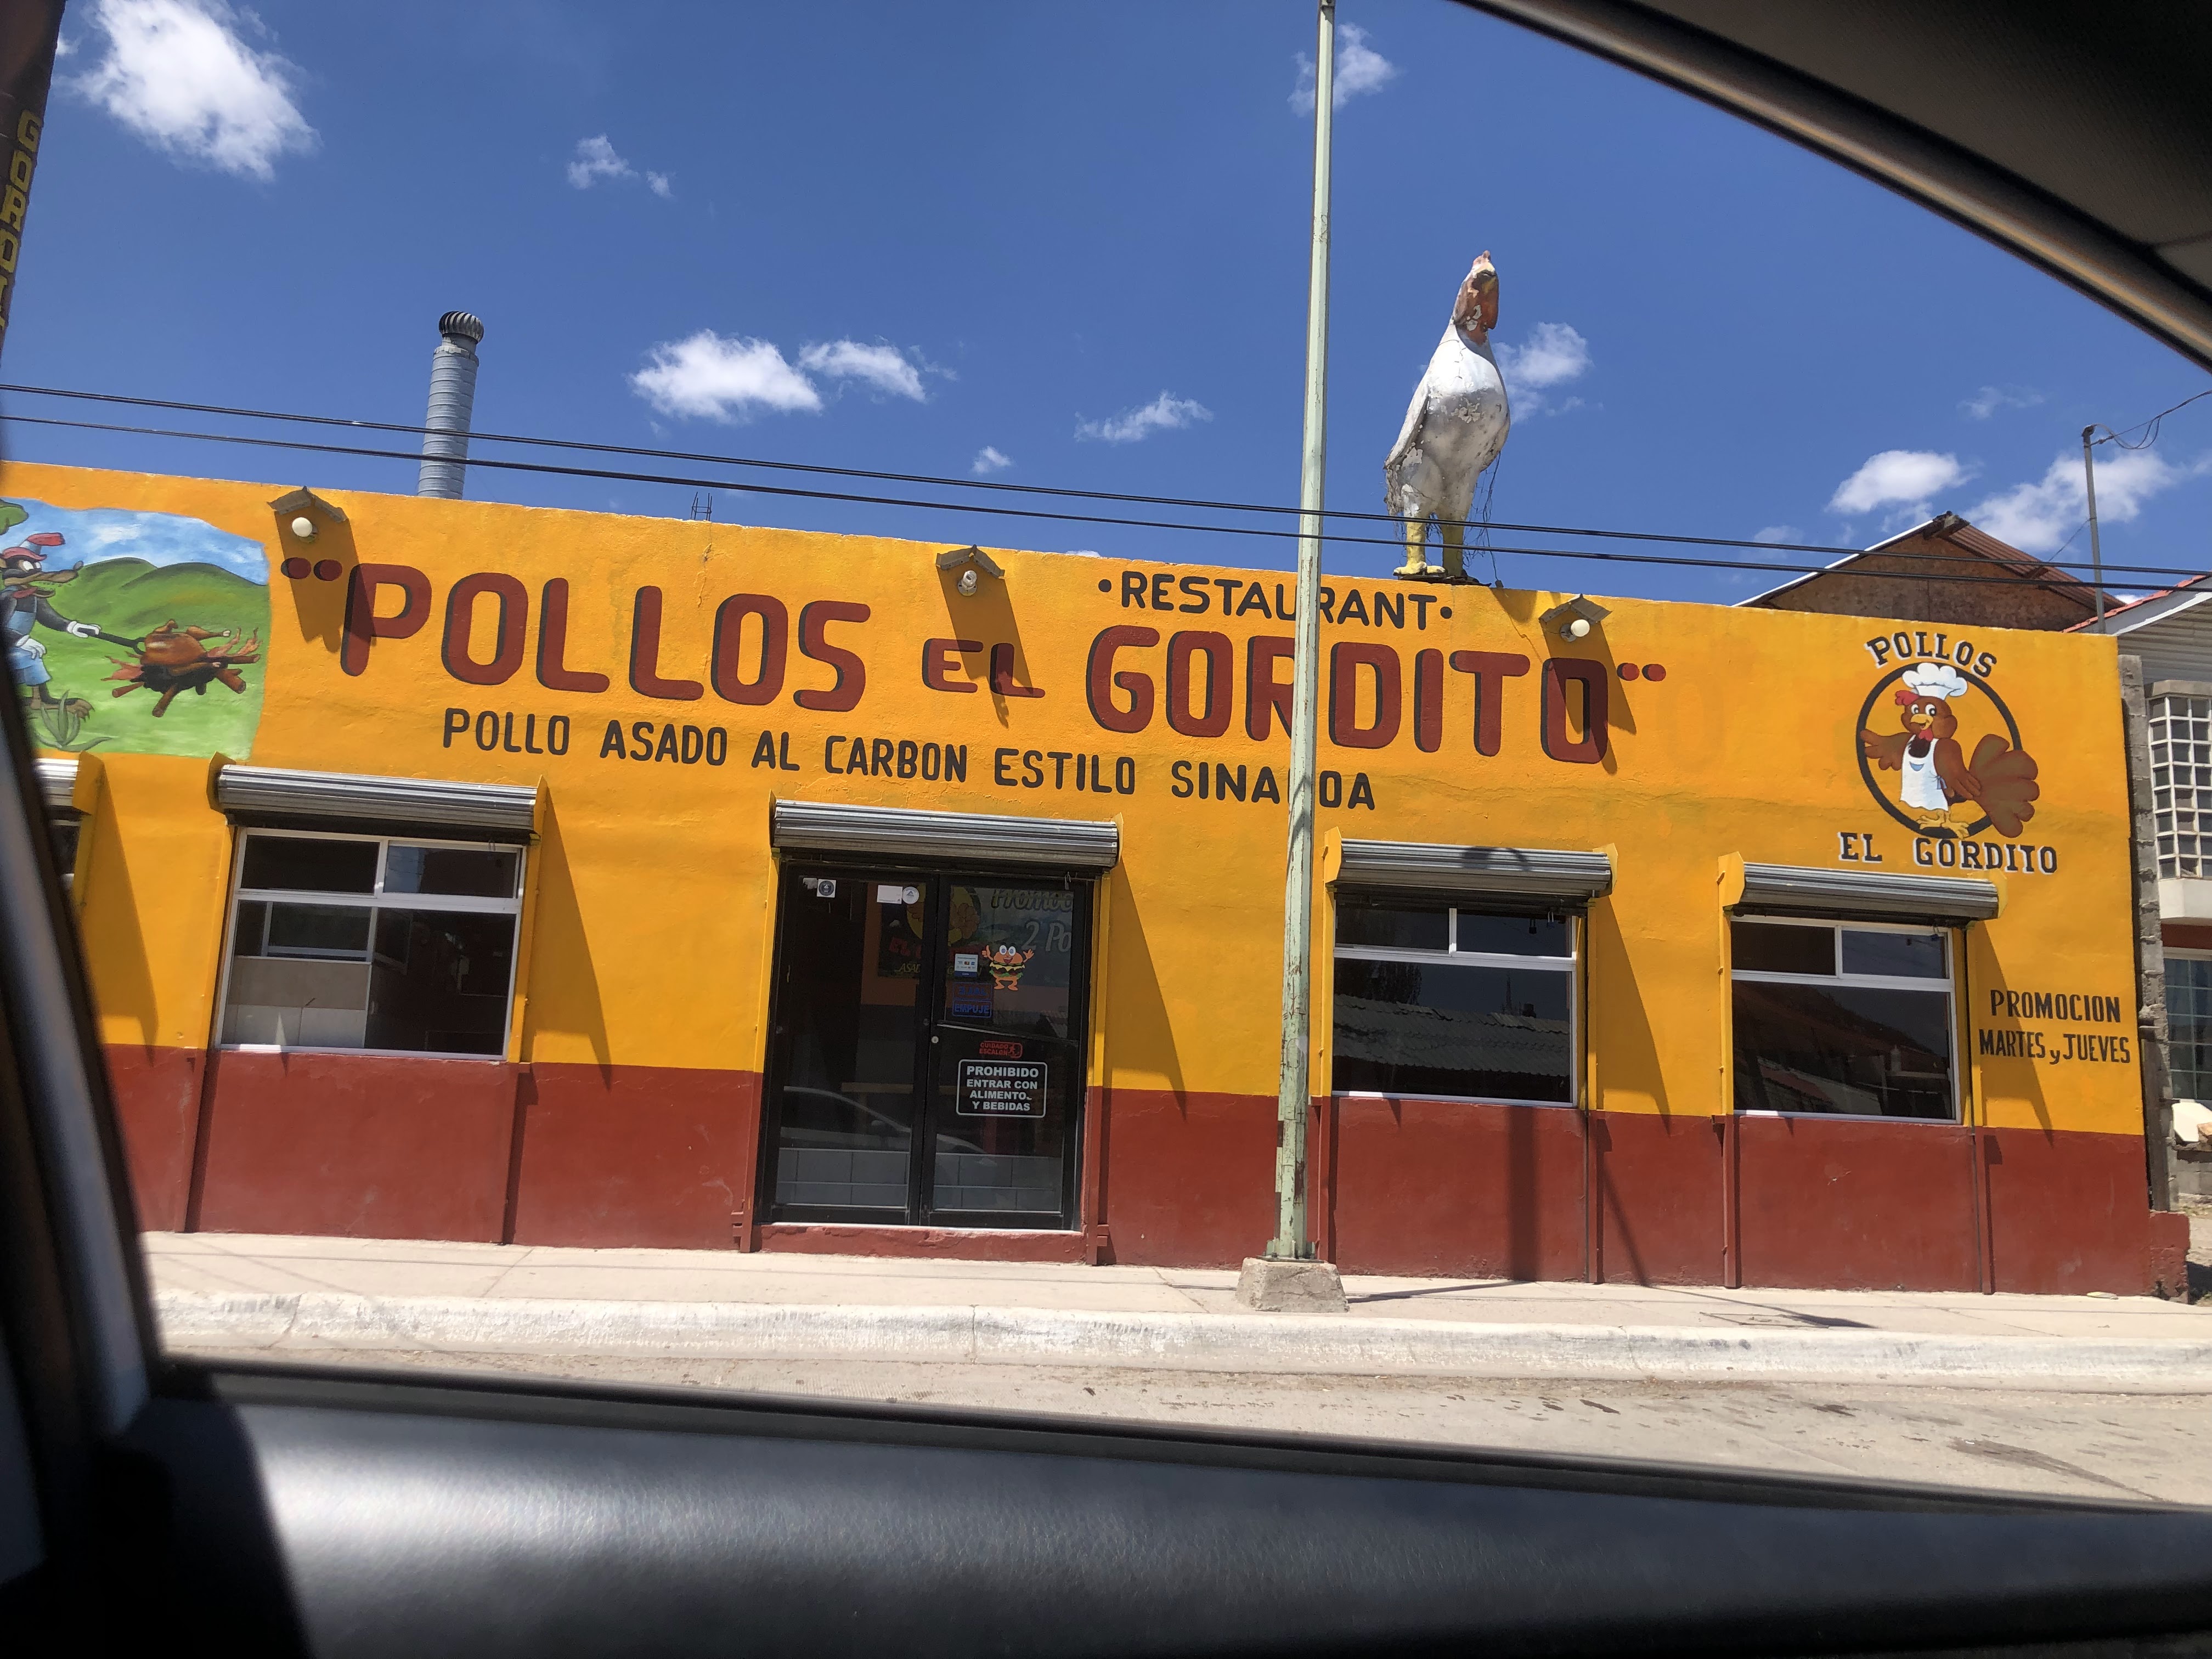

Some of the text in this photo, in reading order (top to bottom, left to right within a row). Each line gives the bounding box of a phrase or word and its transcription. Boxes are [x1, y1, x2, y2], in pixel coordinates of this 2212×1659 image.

[1121, 571, 1438, 630] RESTAURANT
[341, 563, 1608, 764] POLLOS EL GORDITO
[1865, 631, 1997, 678] POLLOS
[443, 708, 1375, 810] POLLO ASADO AL CARBON ESTILO SINAOA
[1838, 832, 2058, 874] EL GORDITO
[955, 1003, 990, 1014] EMPUJE
[1990, 990, 2120, 1023] PROMOCION
[1979, 1029, 2045, 1059] MARTES
[2063, 1034, 2130, 1063] JUEVES
[967, 1066, 1039, 1077] PROHIBIDO
[967, 1079, 1038, 1090] ENTRAR CON
[972, 1101, 1031, 1111] Y BEBIDAS
